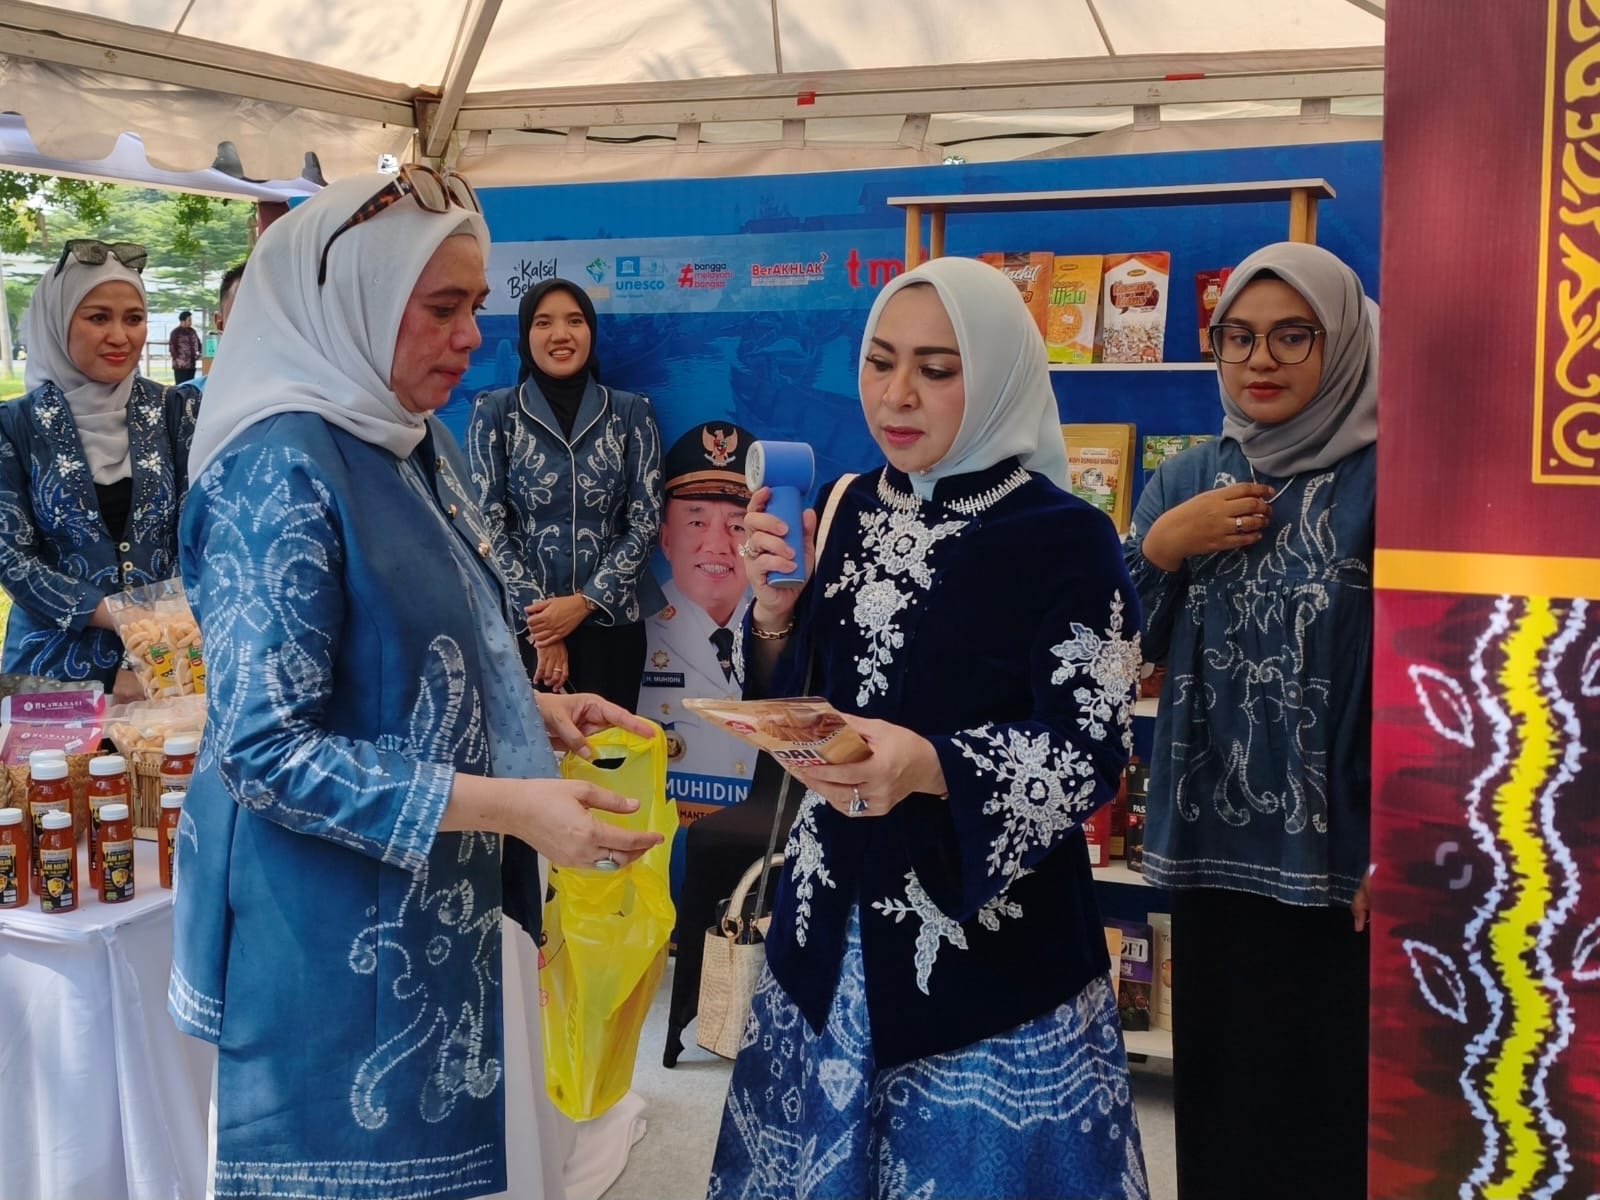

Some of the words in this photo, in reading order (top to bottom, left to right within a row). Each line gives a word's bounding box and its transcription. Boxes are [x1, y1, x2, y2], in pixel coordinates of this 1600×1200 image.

[521, 258, 557, 280] Kalsel
[694, 263, 727, 272] bangga
[752, 263, 823, 277] BerAKHLAK
[616, 280, 665, 290] unesco
[666, 778, 749, 803] MUHIDIN
[1132, 804, 1147, 814] PAS
[679, 810, 709, 820] MANT
